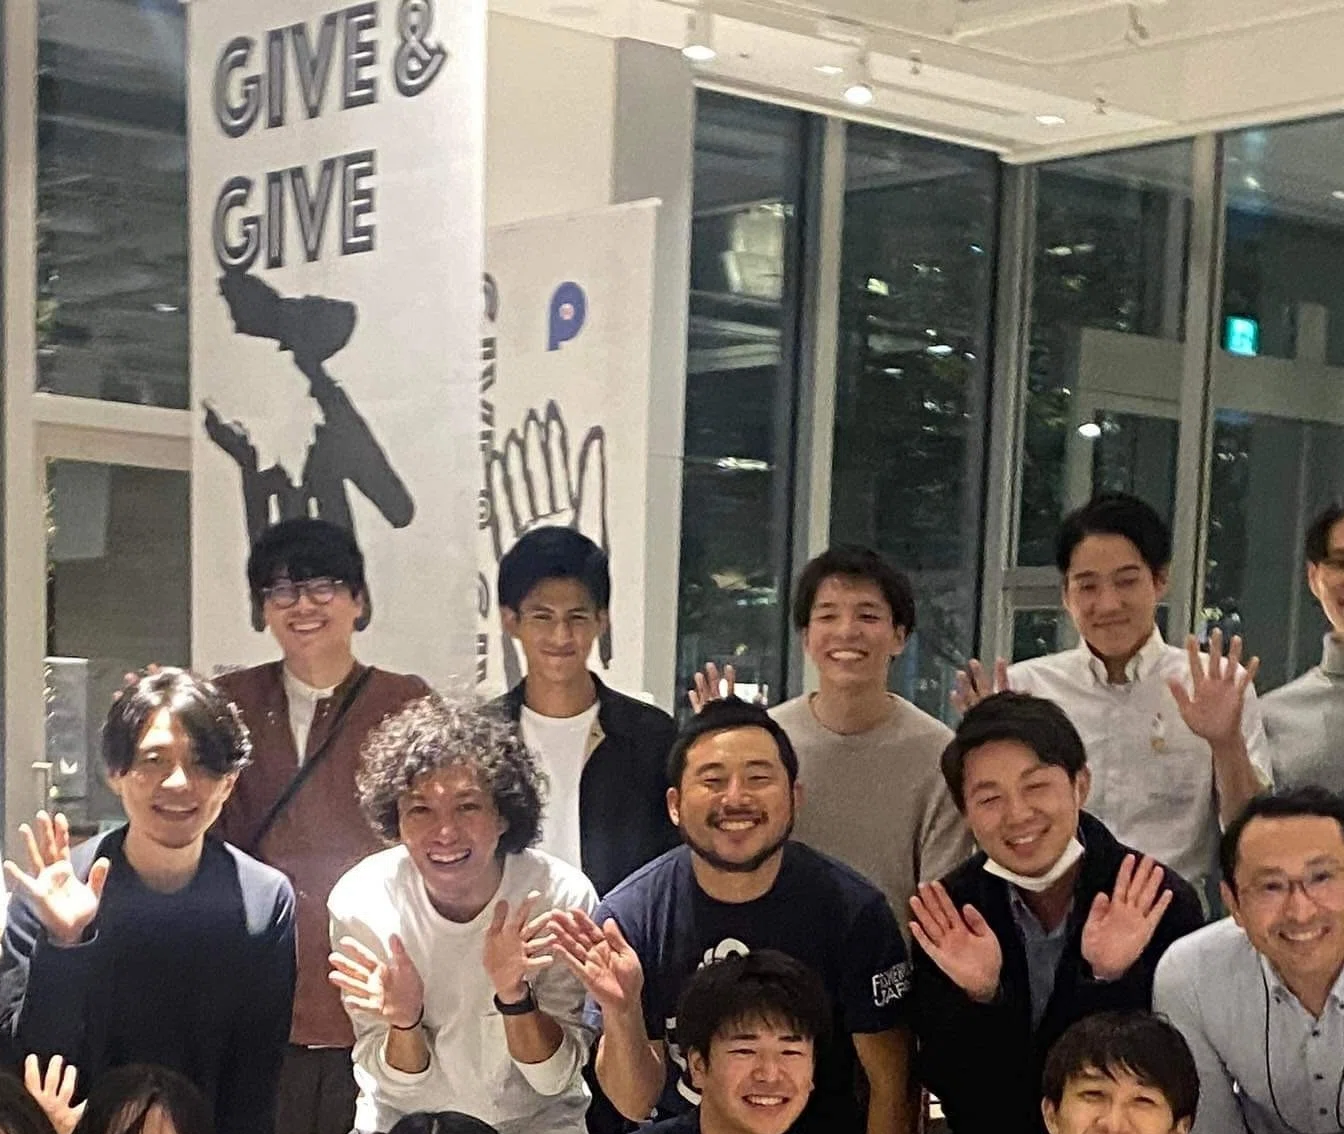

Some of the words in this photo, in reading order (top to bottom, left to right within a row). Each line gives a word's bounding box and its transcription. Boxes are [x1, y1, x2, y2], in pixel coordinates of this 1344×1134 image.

[214, 1, 379, 138] GIVE
[395, 0, 447, 97] &
[214, 149, 377, 271] GIVE
